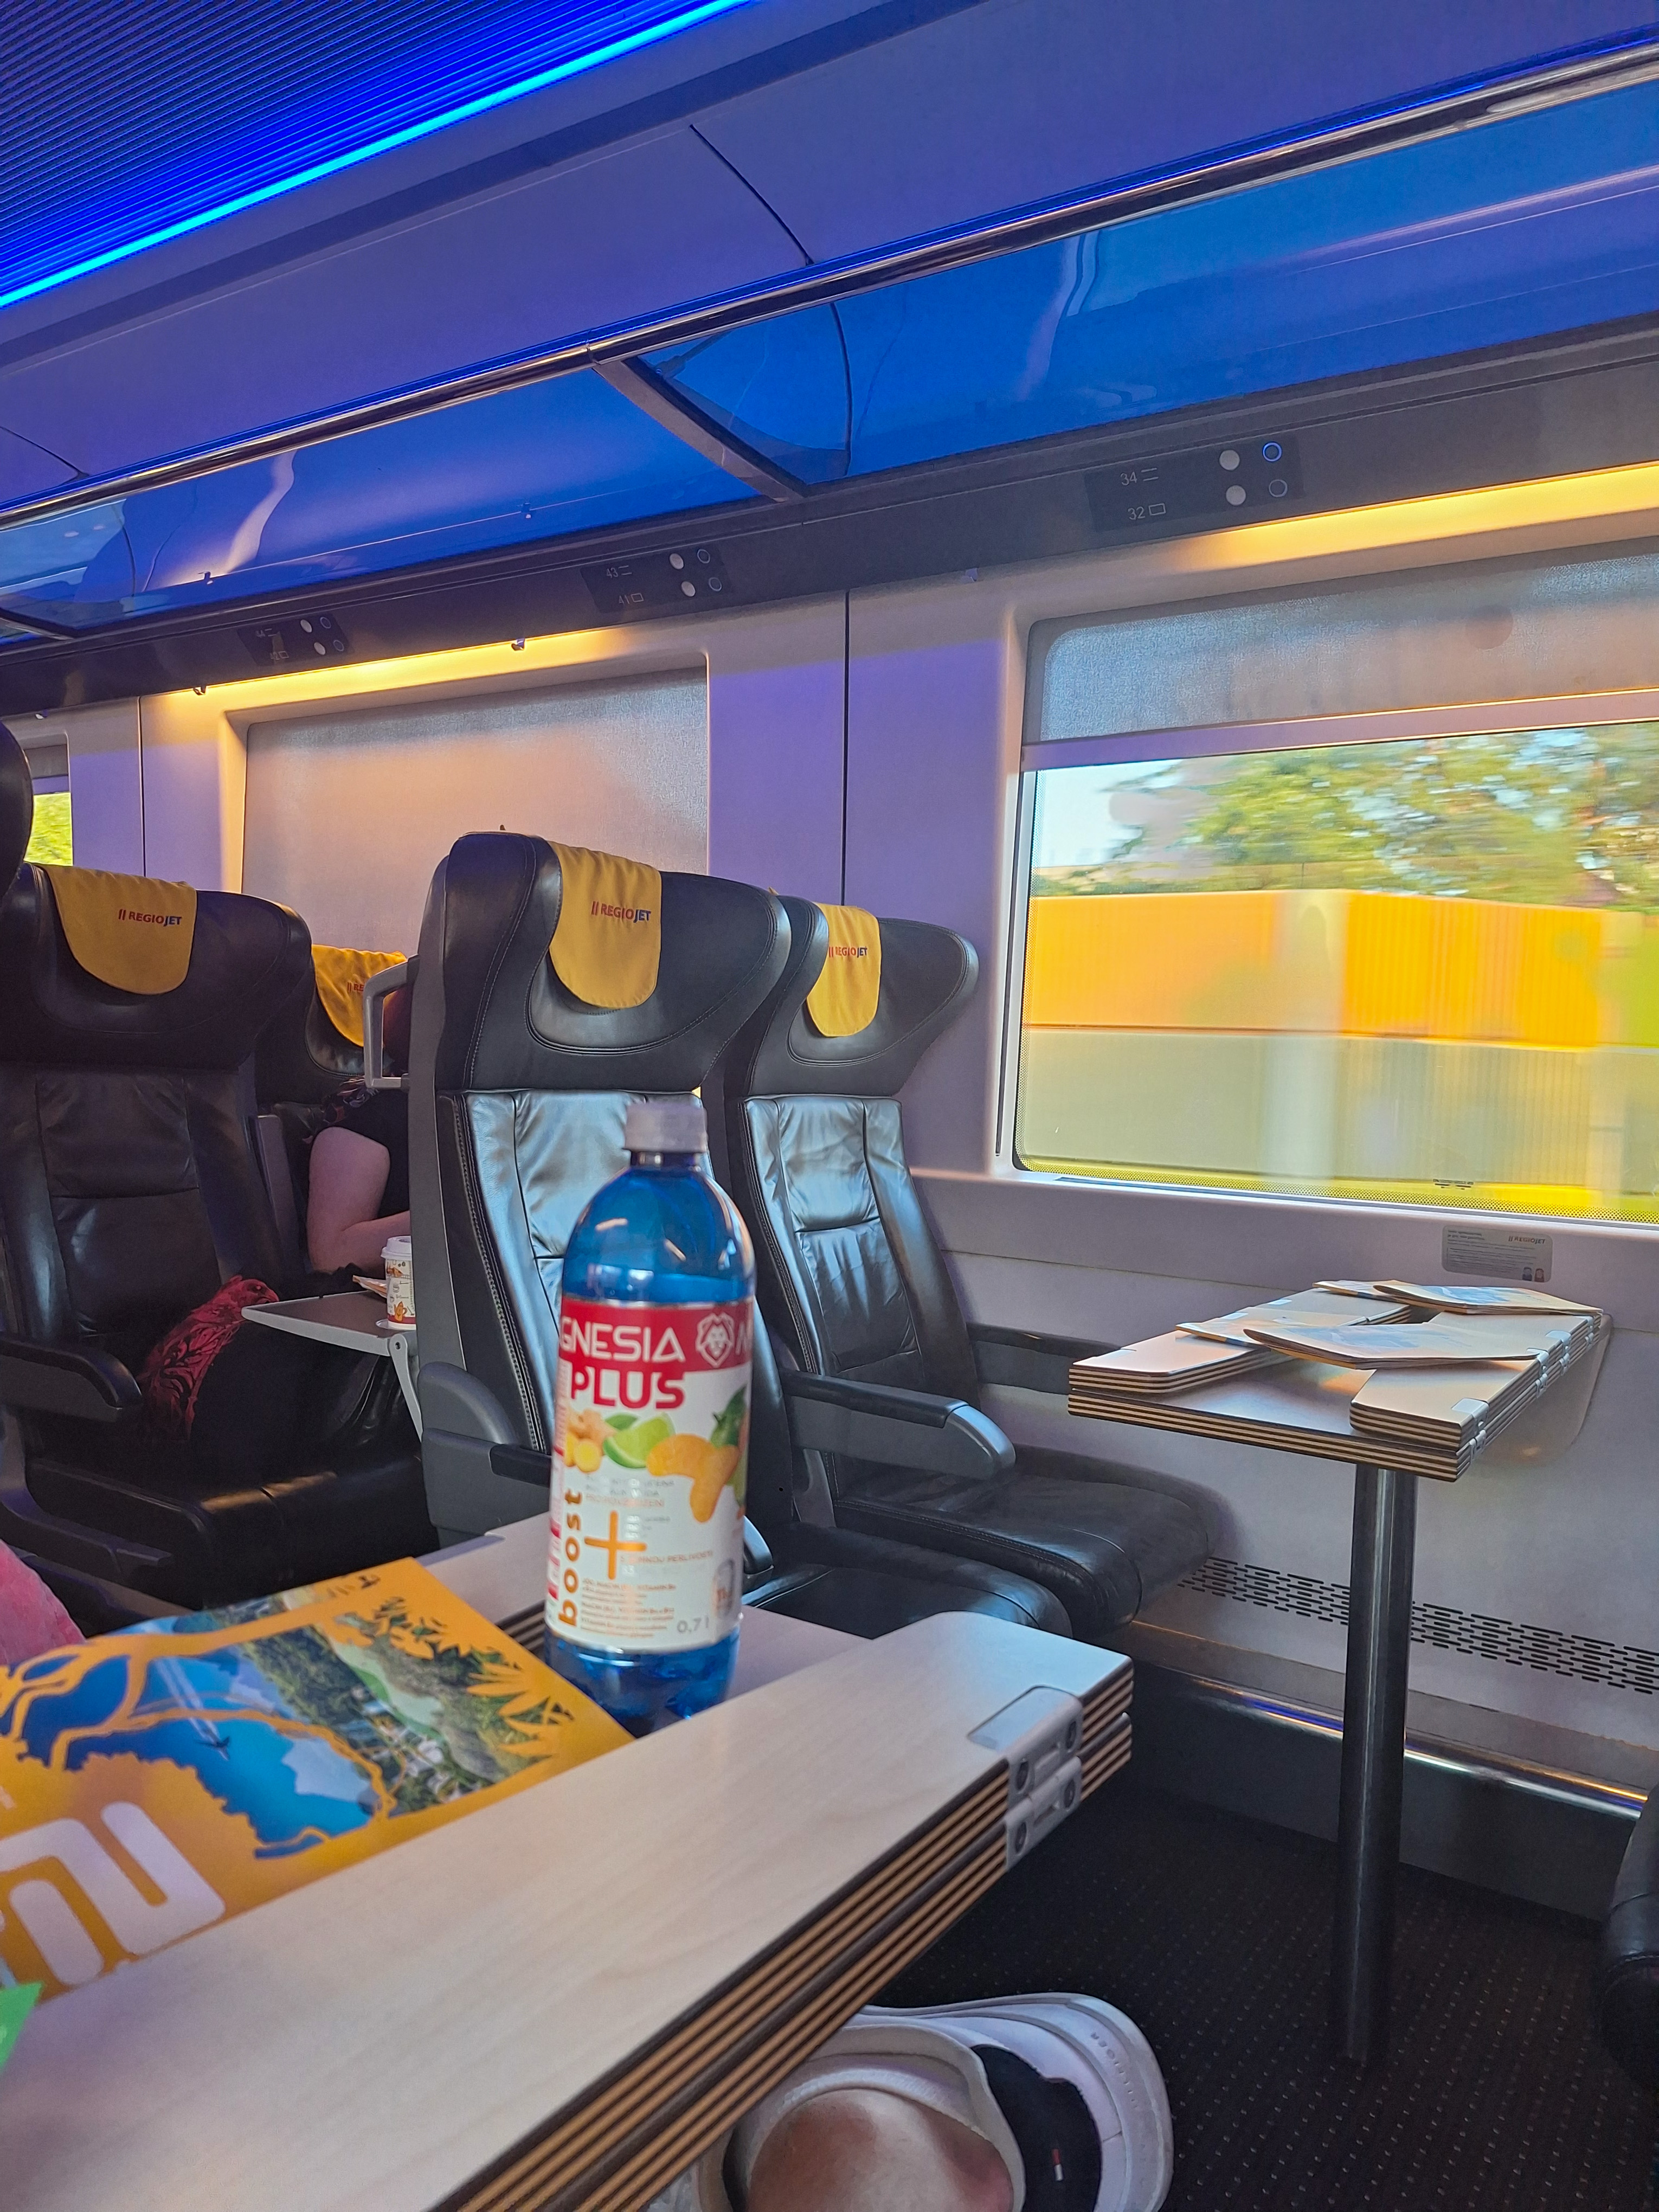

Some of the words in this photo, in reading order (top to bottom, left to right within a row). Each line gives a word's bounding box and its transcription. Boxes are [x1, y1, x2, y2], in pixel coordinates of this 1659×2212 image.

[1120, 471, 1137, 486] 34
[1128, 506, 1146, 520] 32
[606, 567, 619, 578] 43
[619, 594, 630, 605] 41
[128, 911, 182, 927] REGIOJET
[600, 903, 652, 923] REGIOJET
[835, 946, 867, 958] REGIOJET
[571, 1366, 685, 1410] PLUS
[558, 1488, 583, 1627] boost
